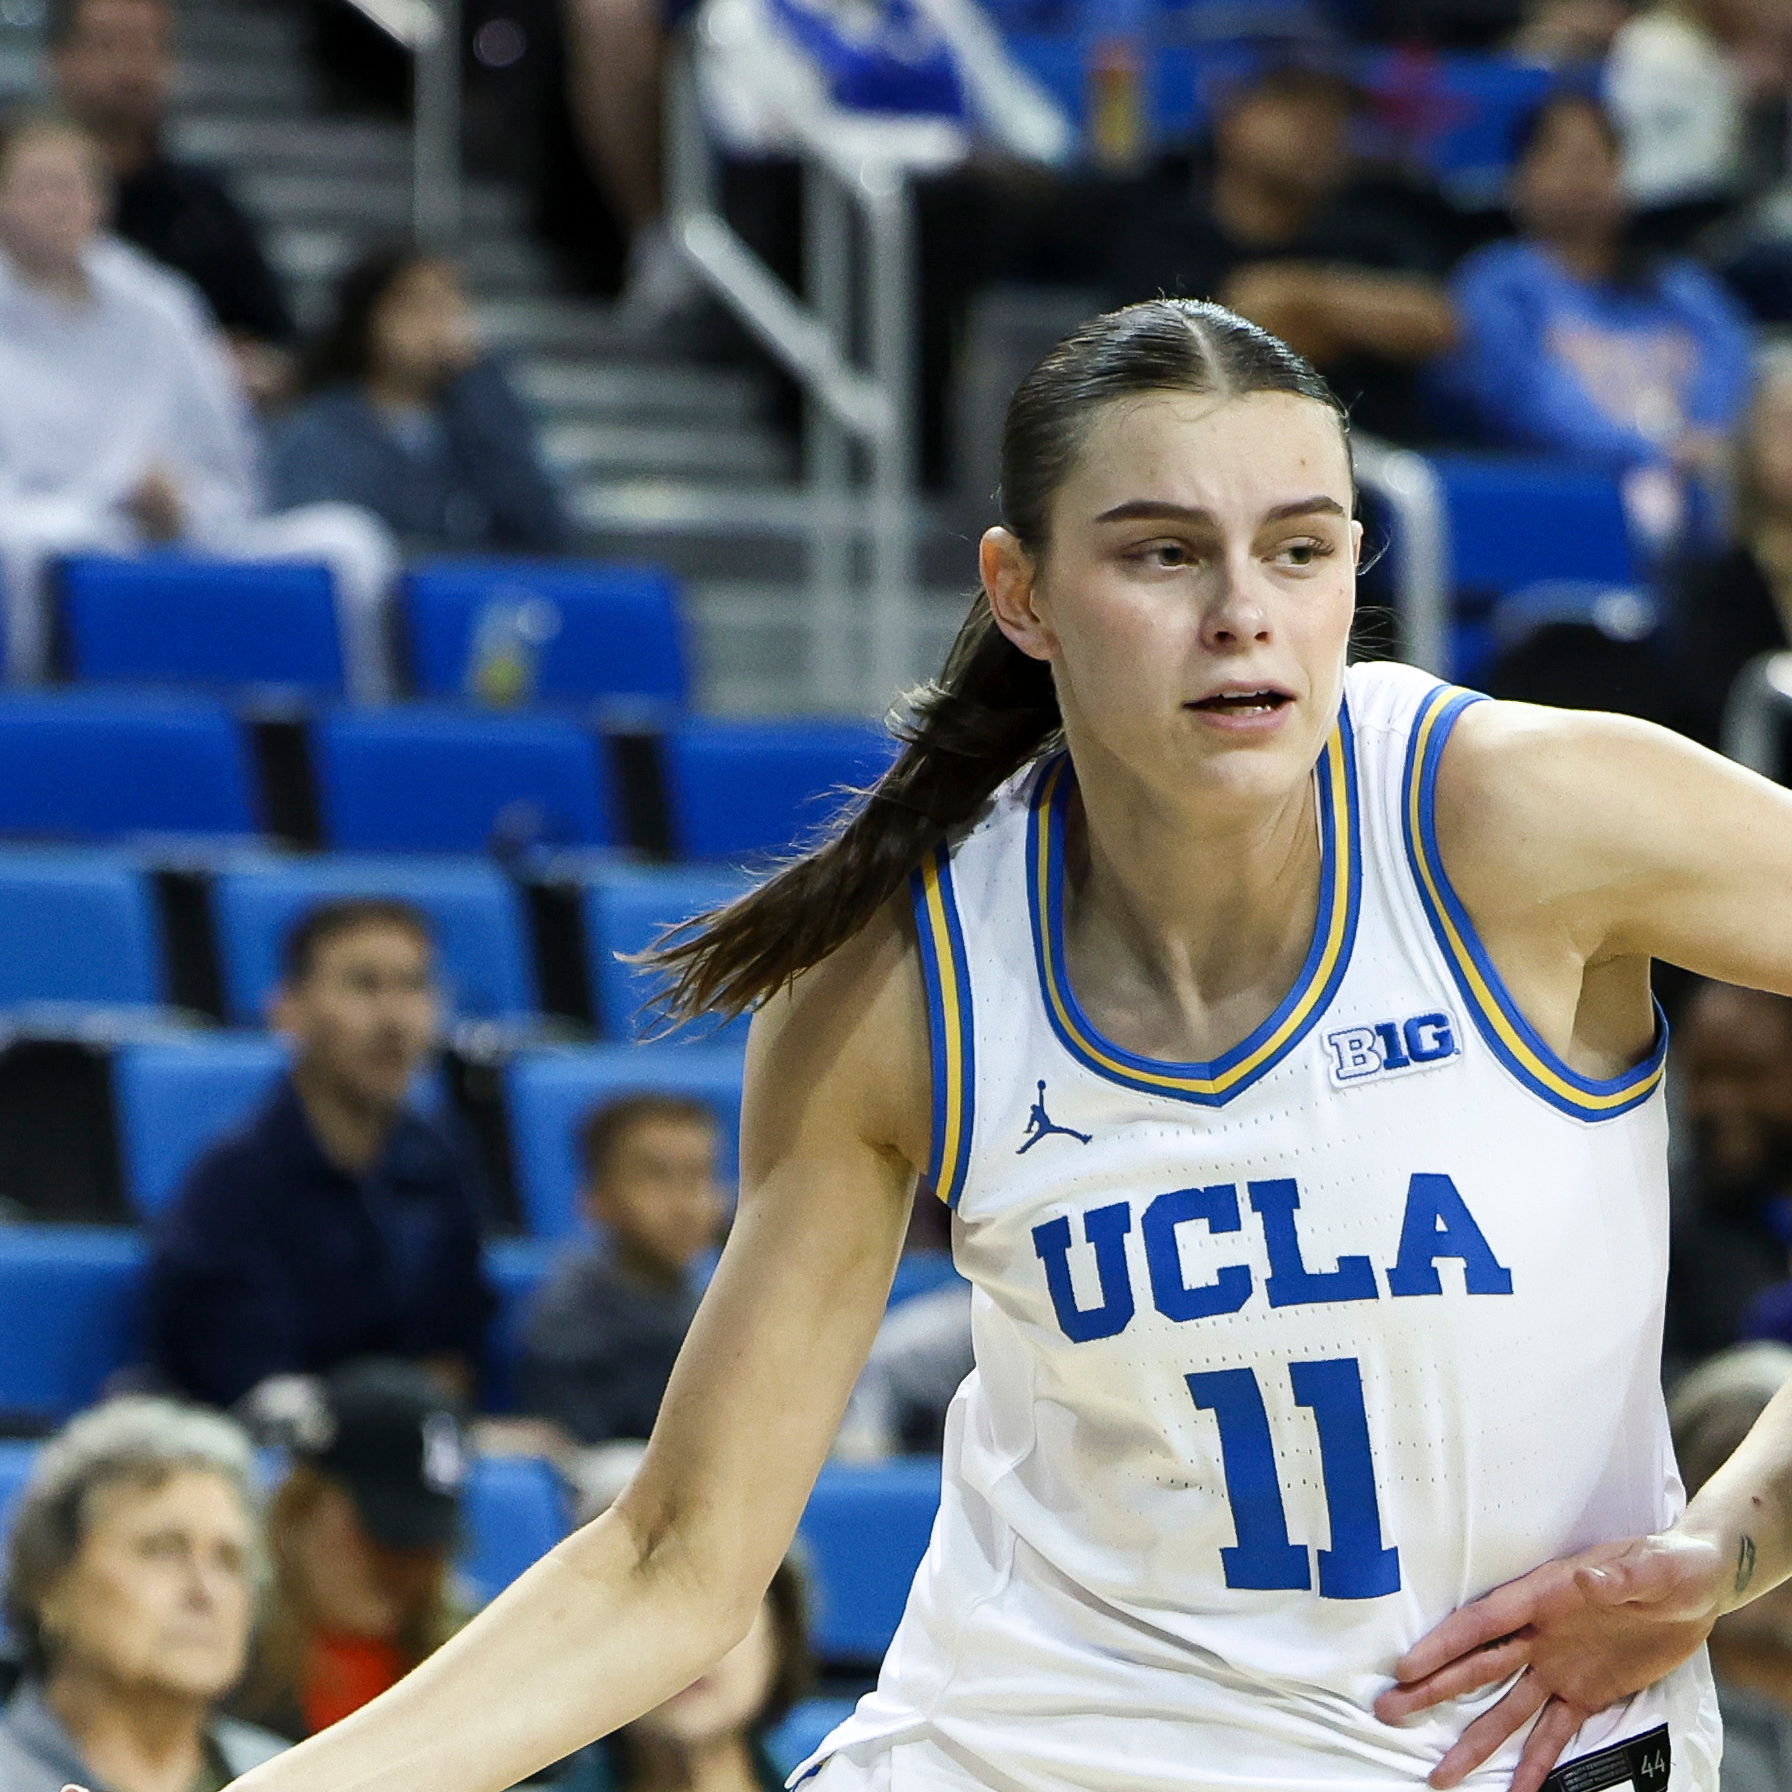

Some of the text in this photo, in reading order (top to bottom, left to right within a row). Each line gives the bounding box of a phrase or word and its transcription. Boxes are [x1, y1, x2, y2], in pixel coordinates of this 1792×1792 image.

[1031, 1172, 1514, 1344] UCLA
[1185, 1357, 1401, 1599] 11
[1640, 1748, 1666, 1779] 44
